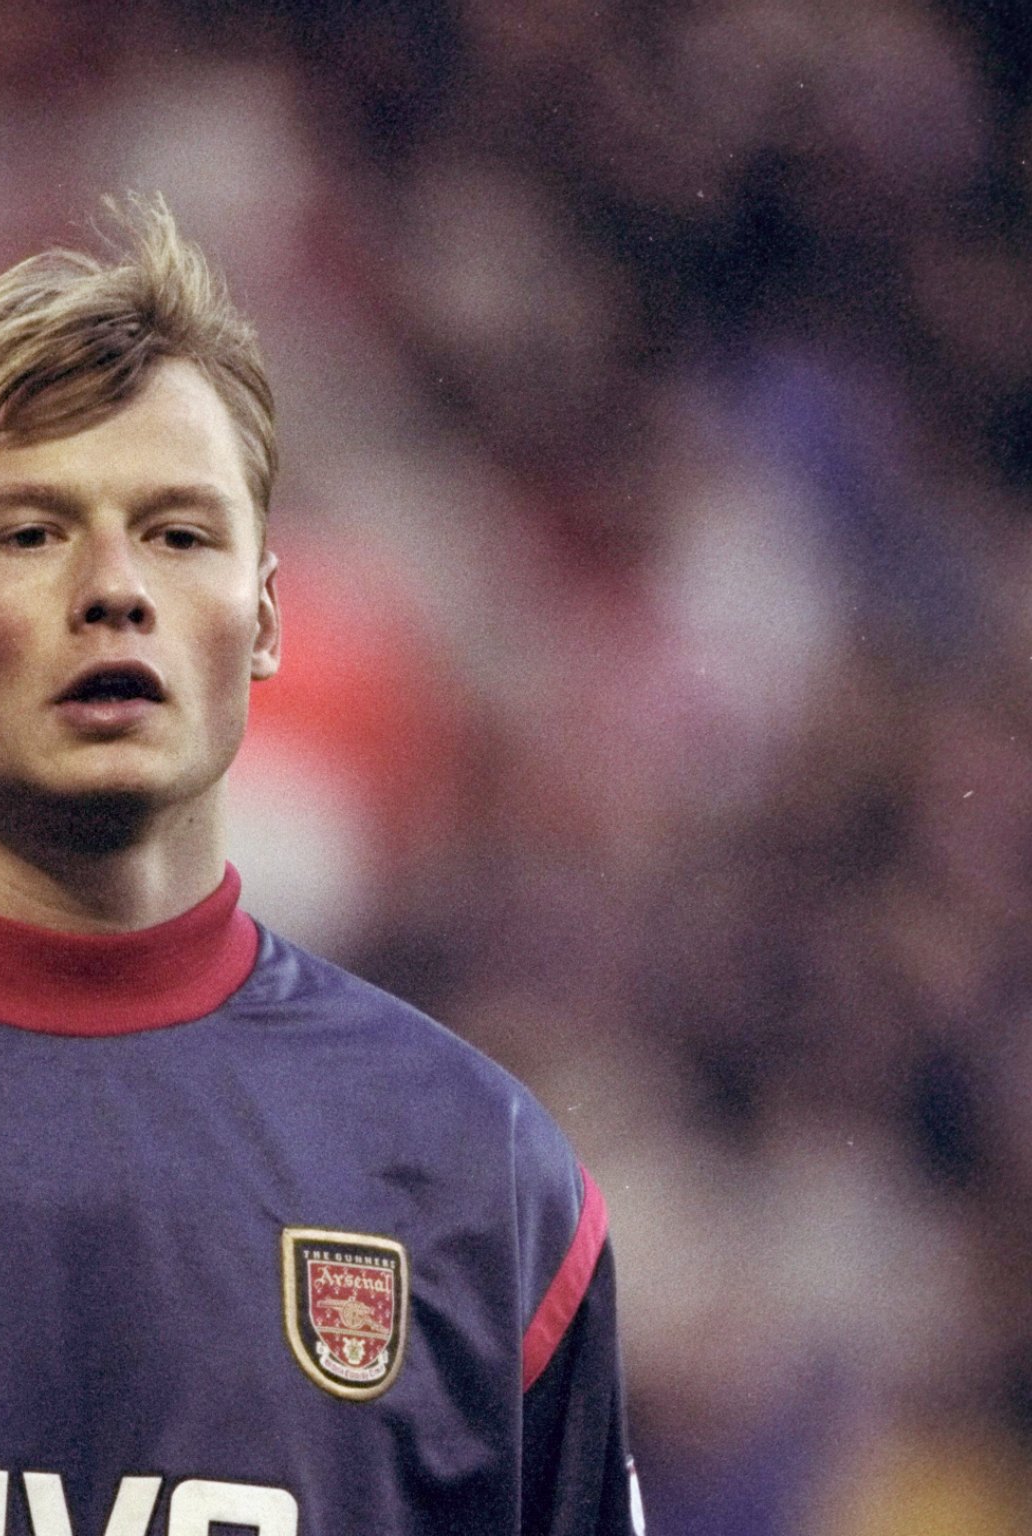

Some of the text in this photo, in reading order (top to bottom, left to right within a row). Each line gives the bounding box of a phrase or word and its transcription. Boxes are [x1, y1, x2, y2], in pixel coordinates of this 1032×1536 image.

[303, 1249, 396, 1270] THE GUNNERS
[314, 1266, 392, 1293] Arsenal
